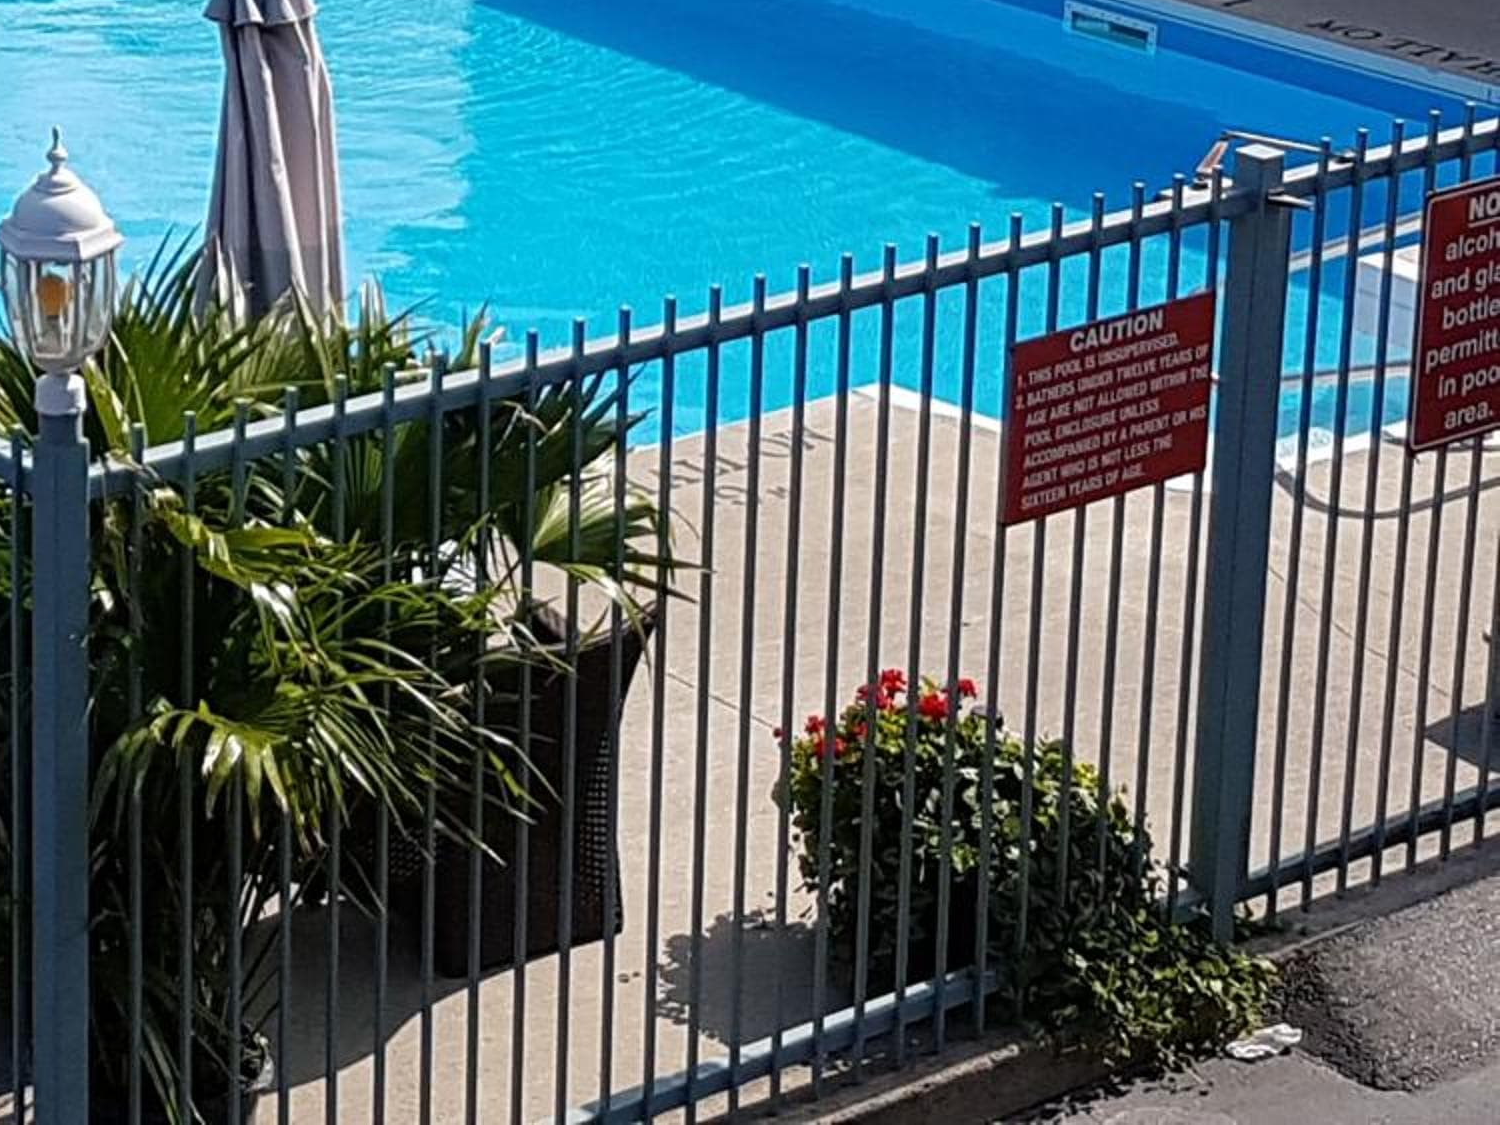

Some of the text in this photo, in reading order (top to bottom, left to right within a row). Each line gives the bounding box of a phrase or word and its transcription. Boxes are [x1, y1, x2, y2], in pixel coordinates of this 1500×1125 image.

[1469, 192, 1500, 221] NO
[1431, 266, 1471, 299] and
[1070, 309, 1164, 352] CAUTION
[1443, 295, 1500, 330] bottle
[1027, 380, 1075, 407] BATHERS
[1077, 370, 1113, 392] UNDER
[1116, 358, 1157, 382] TWELVE
[1160, 348, 1193, 370] YEARS
[1195, 343, 1209, 360] OF
[1028, 366, 1052, 385] THIS
[1054, 358, 1082, 378] POOL
[1085, 354, 1096, 369] IS
[1438, 374, 1457, 399] in
[1026, 363, 1209, 428] AGE ARE NOT ALLOWED WITHIN THE
[1444, 401, 1493, 429] area.
[1023, 403, 1206, 471] ACCOMPANIED BY A PARENT OR HIS
[1025, 399, 1160, 449] POOL ENCLOSURE UNLESS
[1022, 467, 1058, 490] AGENT
[1060, 459, 1085, 478] WHO
[1087, 455, 1099, 472] IS
[1101, 448, 1121, 467] NOT
[1123, 439, 1151, 462] LESS
[1020, 483, 1067, 511] SIXTEEN
[1068, 475, 1103, 496] YEARS
[1105, 469, 1119, 486] OF
